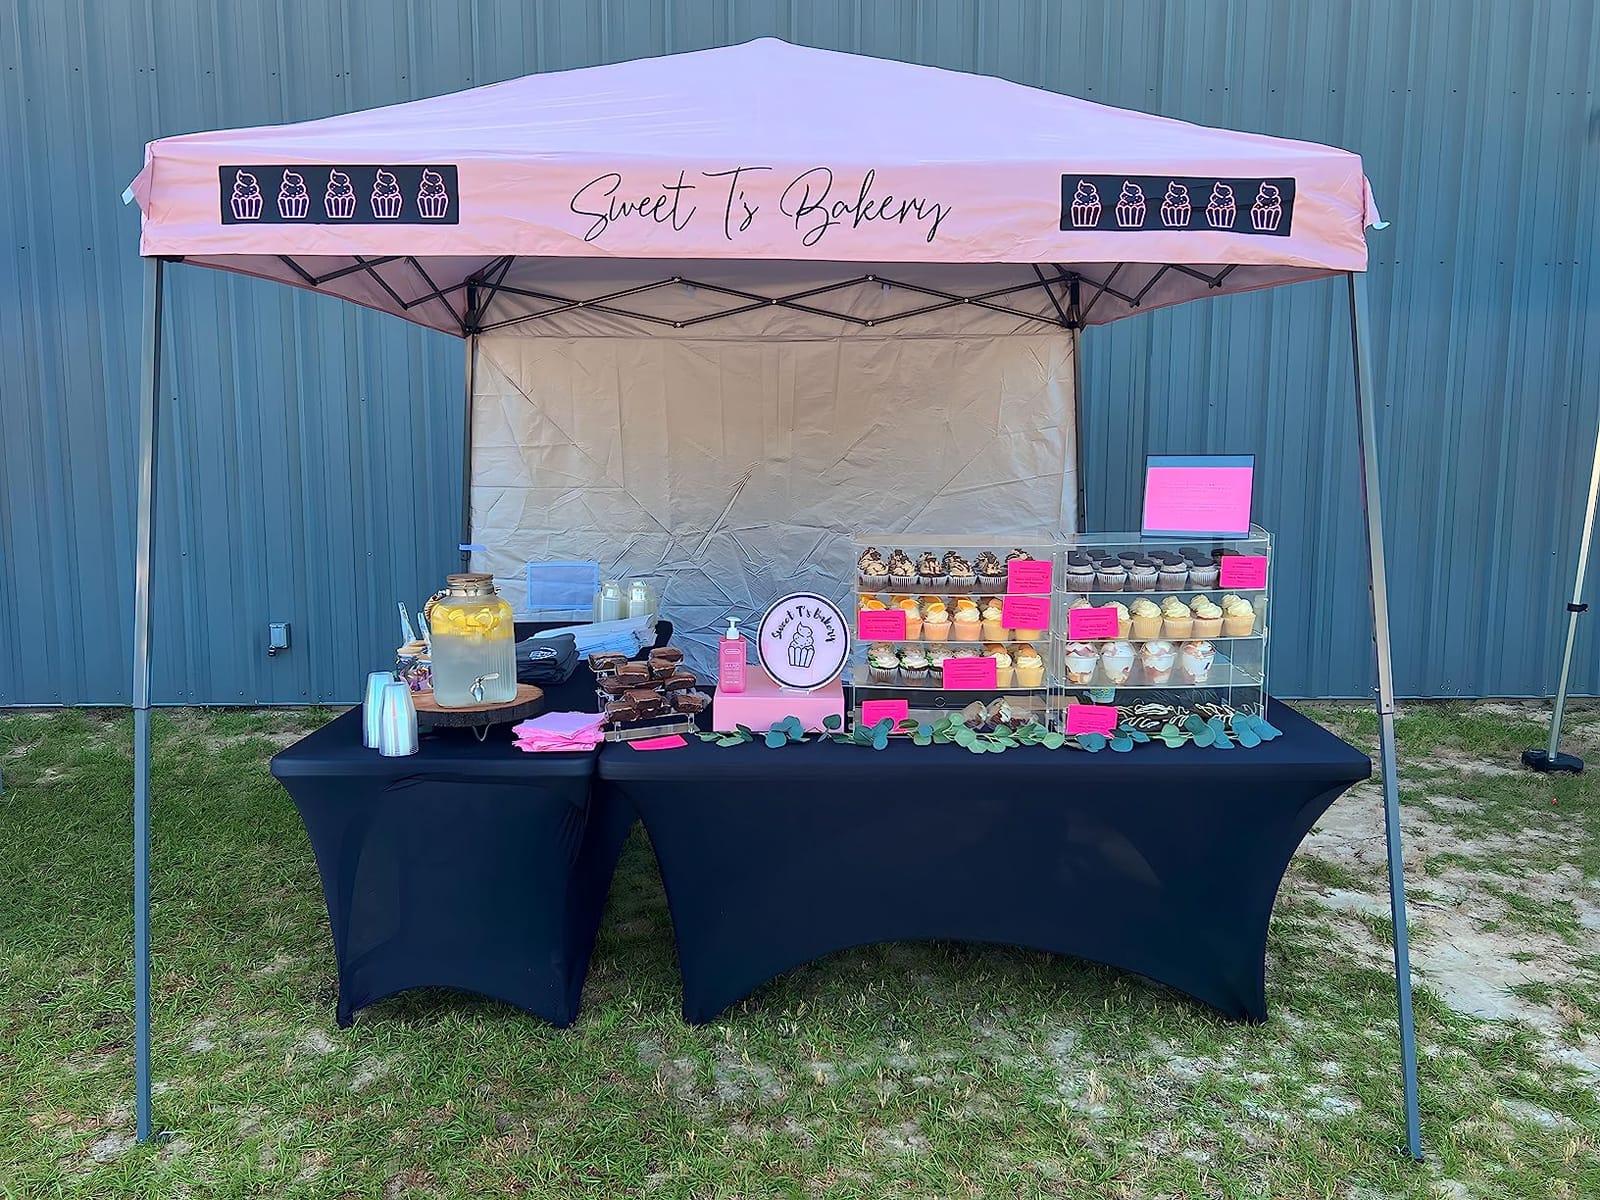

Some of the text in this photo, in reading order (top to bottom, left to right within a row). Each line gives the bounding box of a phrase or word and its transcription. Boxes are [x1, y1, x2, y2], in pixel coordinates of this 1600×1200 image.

[570, 166, 952, 247] Sweet T's Bakery
[771, 610, 794, 639] Sweet
